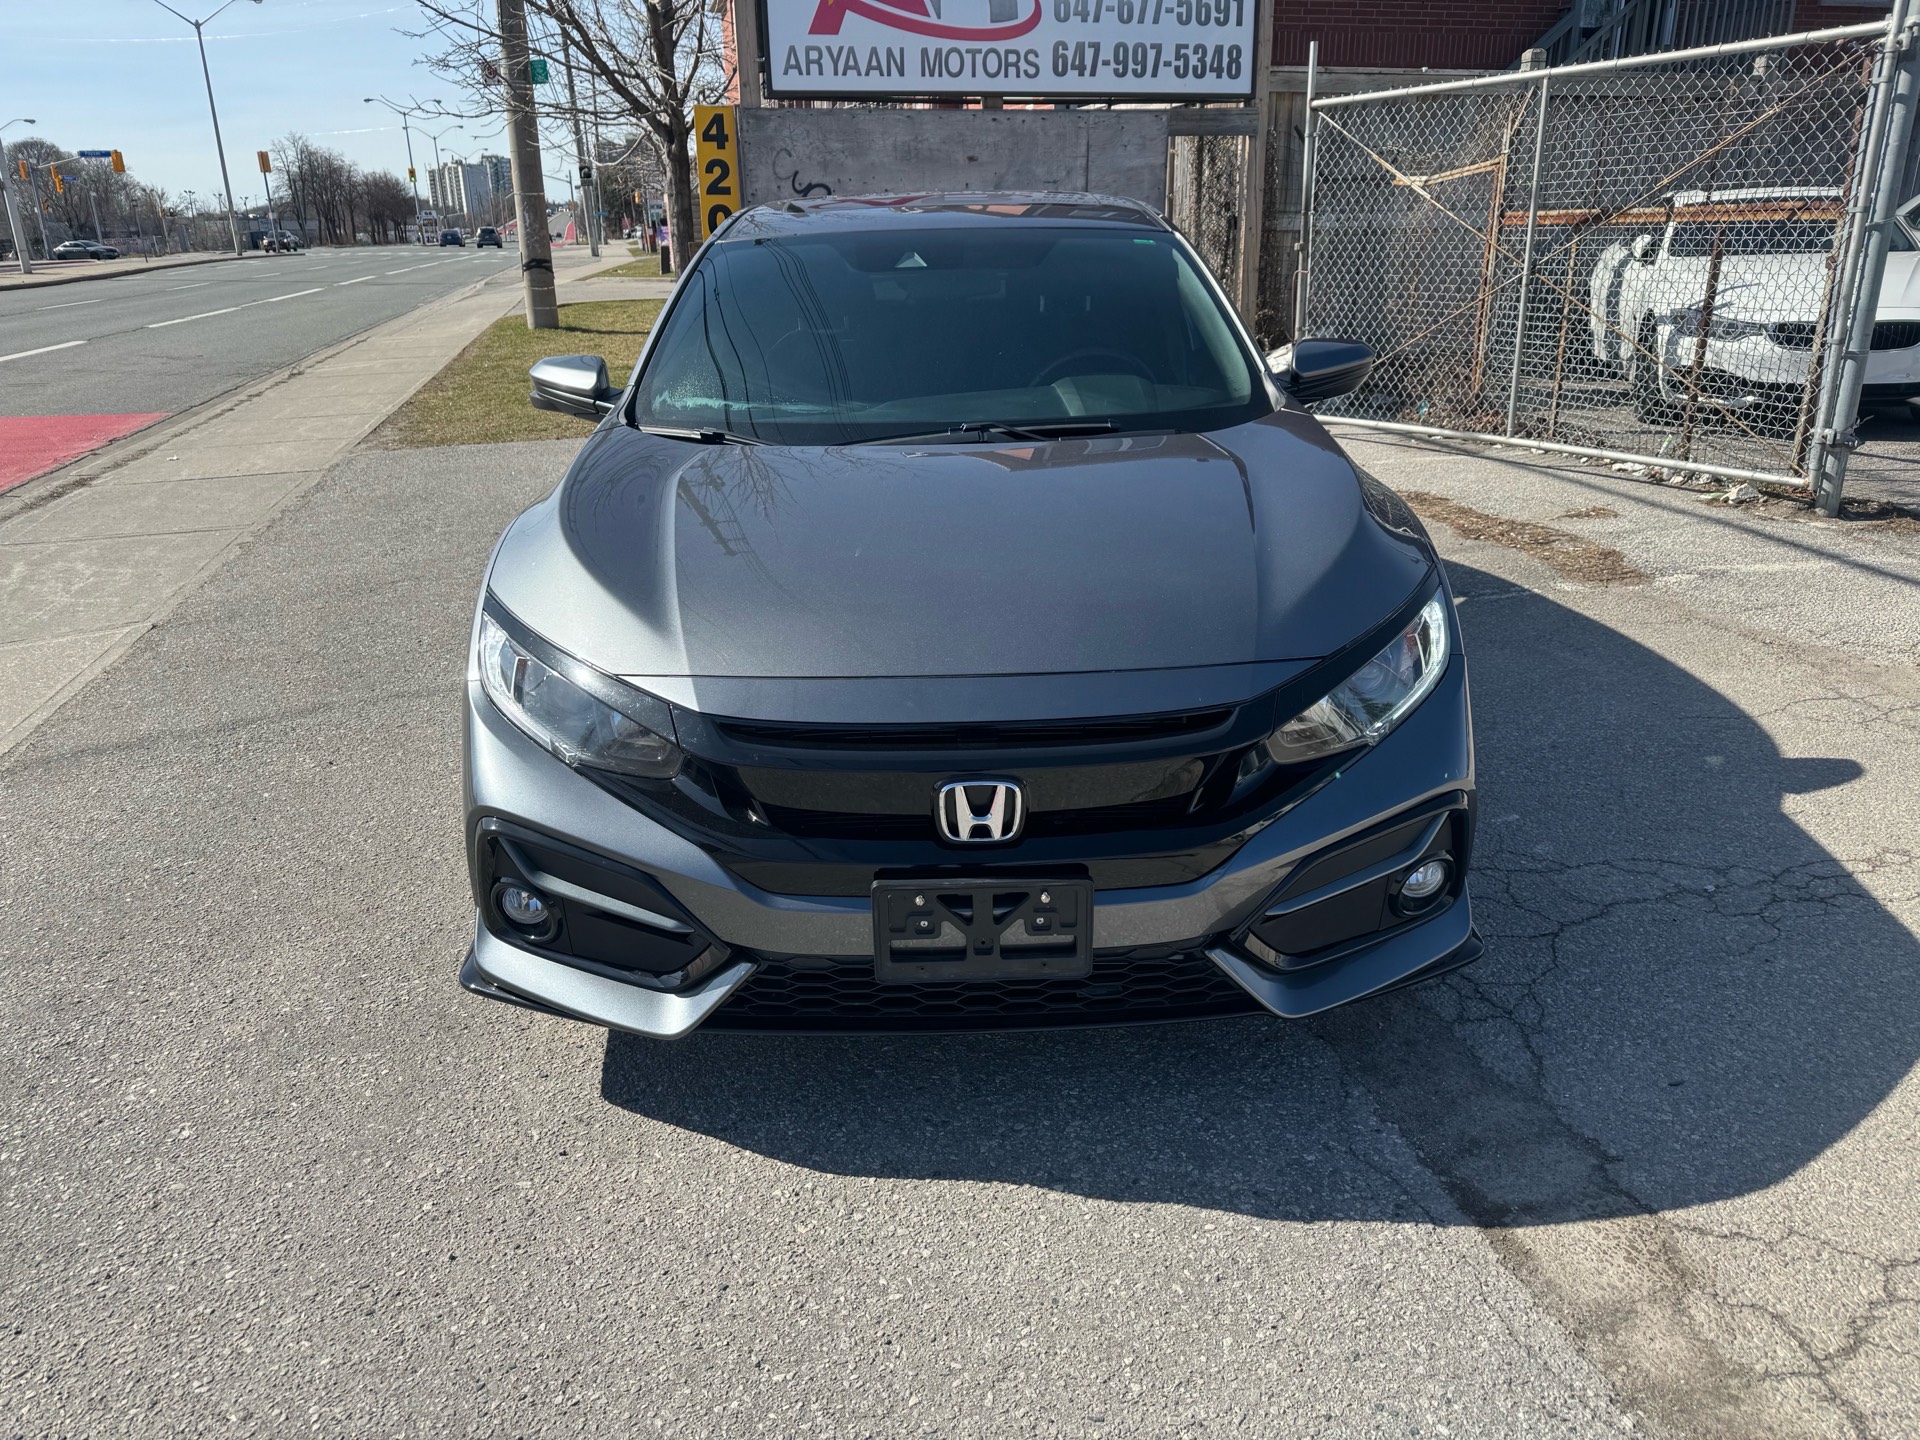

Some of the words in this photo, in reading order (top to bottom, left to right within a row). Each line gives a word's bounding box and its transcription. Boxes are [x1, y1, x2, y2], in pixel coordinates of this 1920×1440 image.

[783, 45, 905, 77] ARYAAN
[920, 47, 1040, 79] MOTORS
[1052, 40, 1242, 80] 647-997-5348
